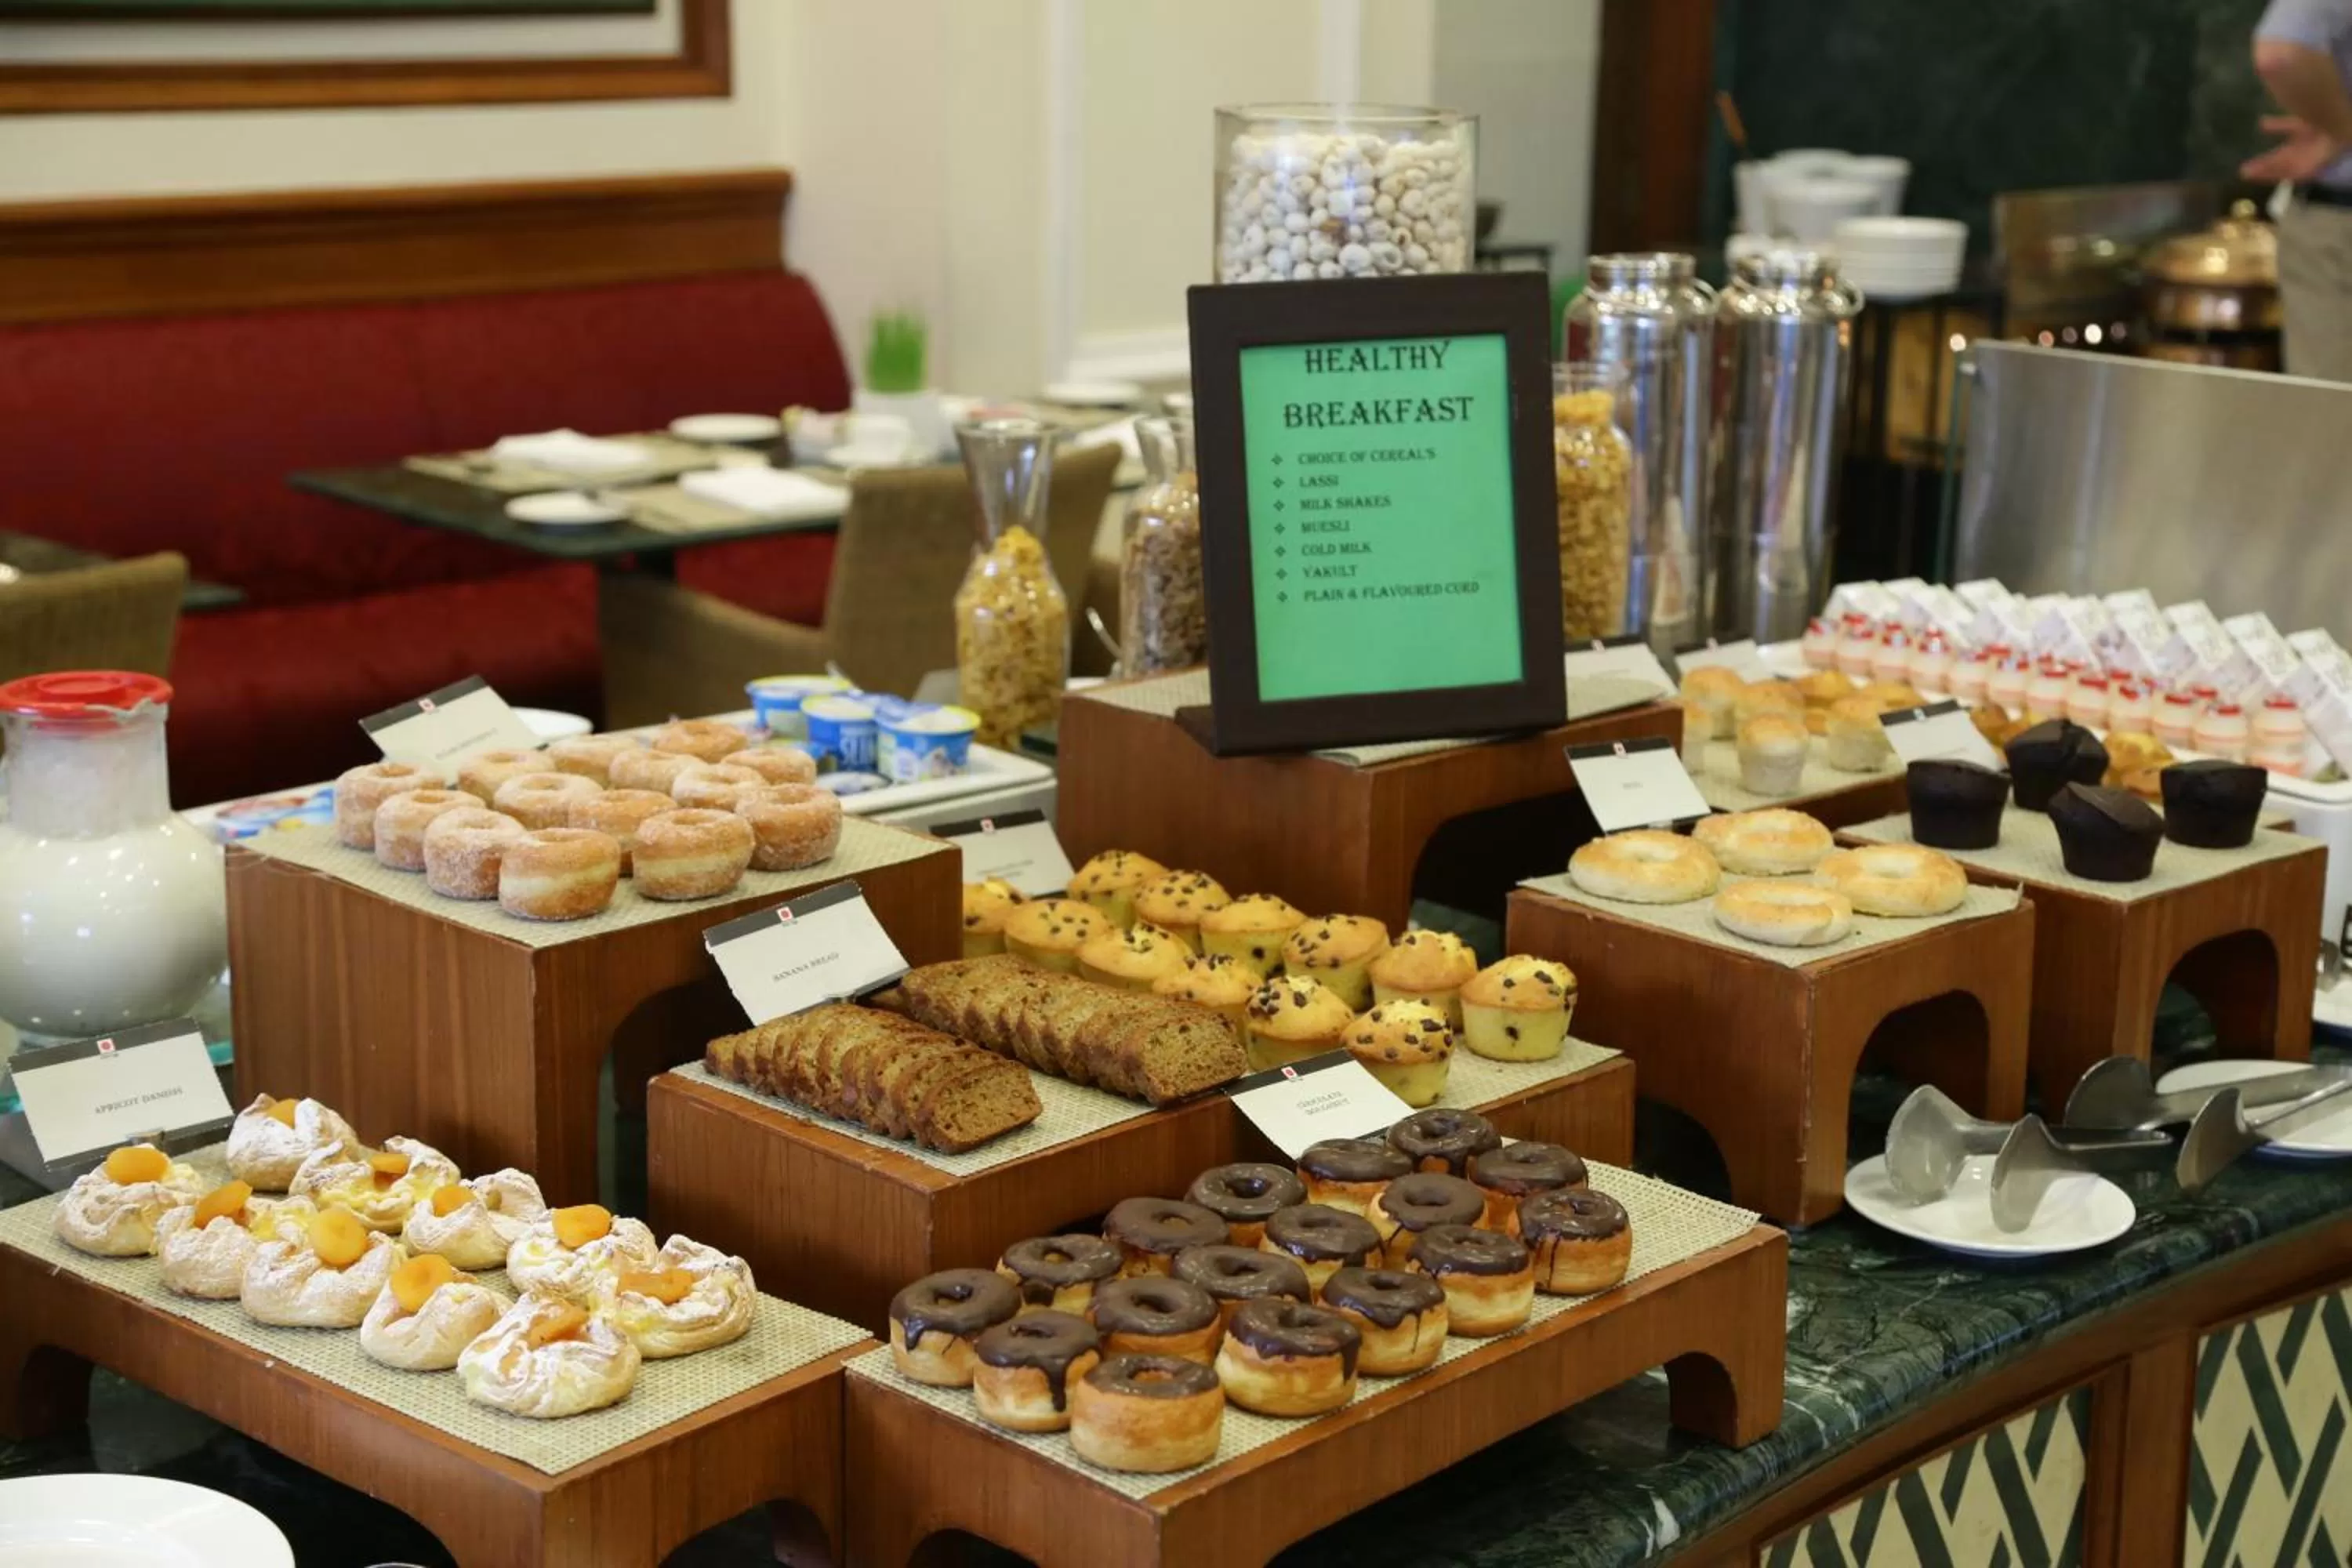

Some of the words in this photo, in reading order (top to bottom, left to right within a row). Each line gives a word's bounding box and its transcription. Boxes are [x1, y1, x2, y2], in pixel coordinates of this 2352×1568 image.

[1305, 339, 1450, 374] HEALTHY
[1283, 396, 1474, 429] BREAKFAST
[1298, 452, 1347, 464] CHOICE
[1349, 451, 1367, 463] OF
[1370, 448, 1436, 463] CEREALS
[1299, 475, 1339, 488] LASSI
[1300, 498, 1332, 510] MILK
[1335, 495, 1392, 508] SHAKES
[1301, 521, 1350, 533] MUESLI
[1301, 543, 1336, 556] COLD
[1339, 542, 1372, 554] MILK
[1301, 564, 1357, 577] YAKULT
[1304, 589, 1344, 602] PLAIN
[1347, 588, 1358, 600] &
[1362, 583, 1443, 599] FLAVOURED
